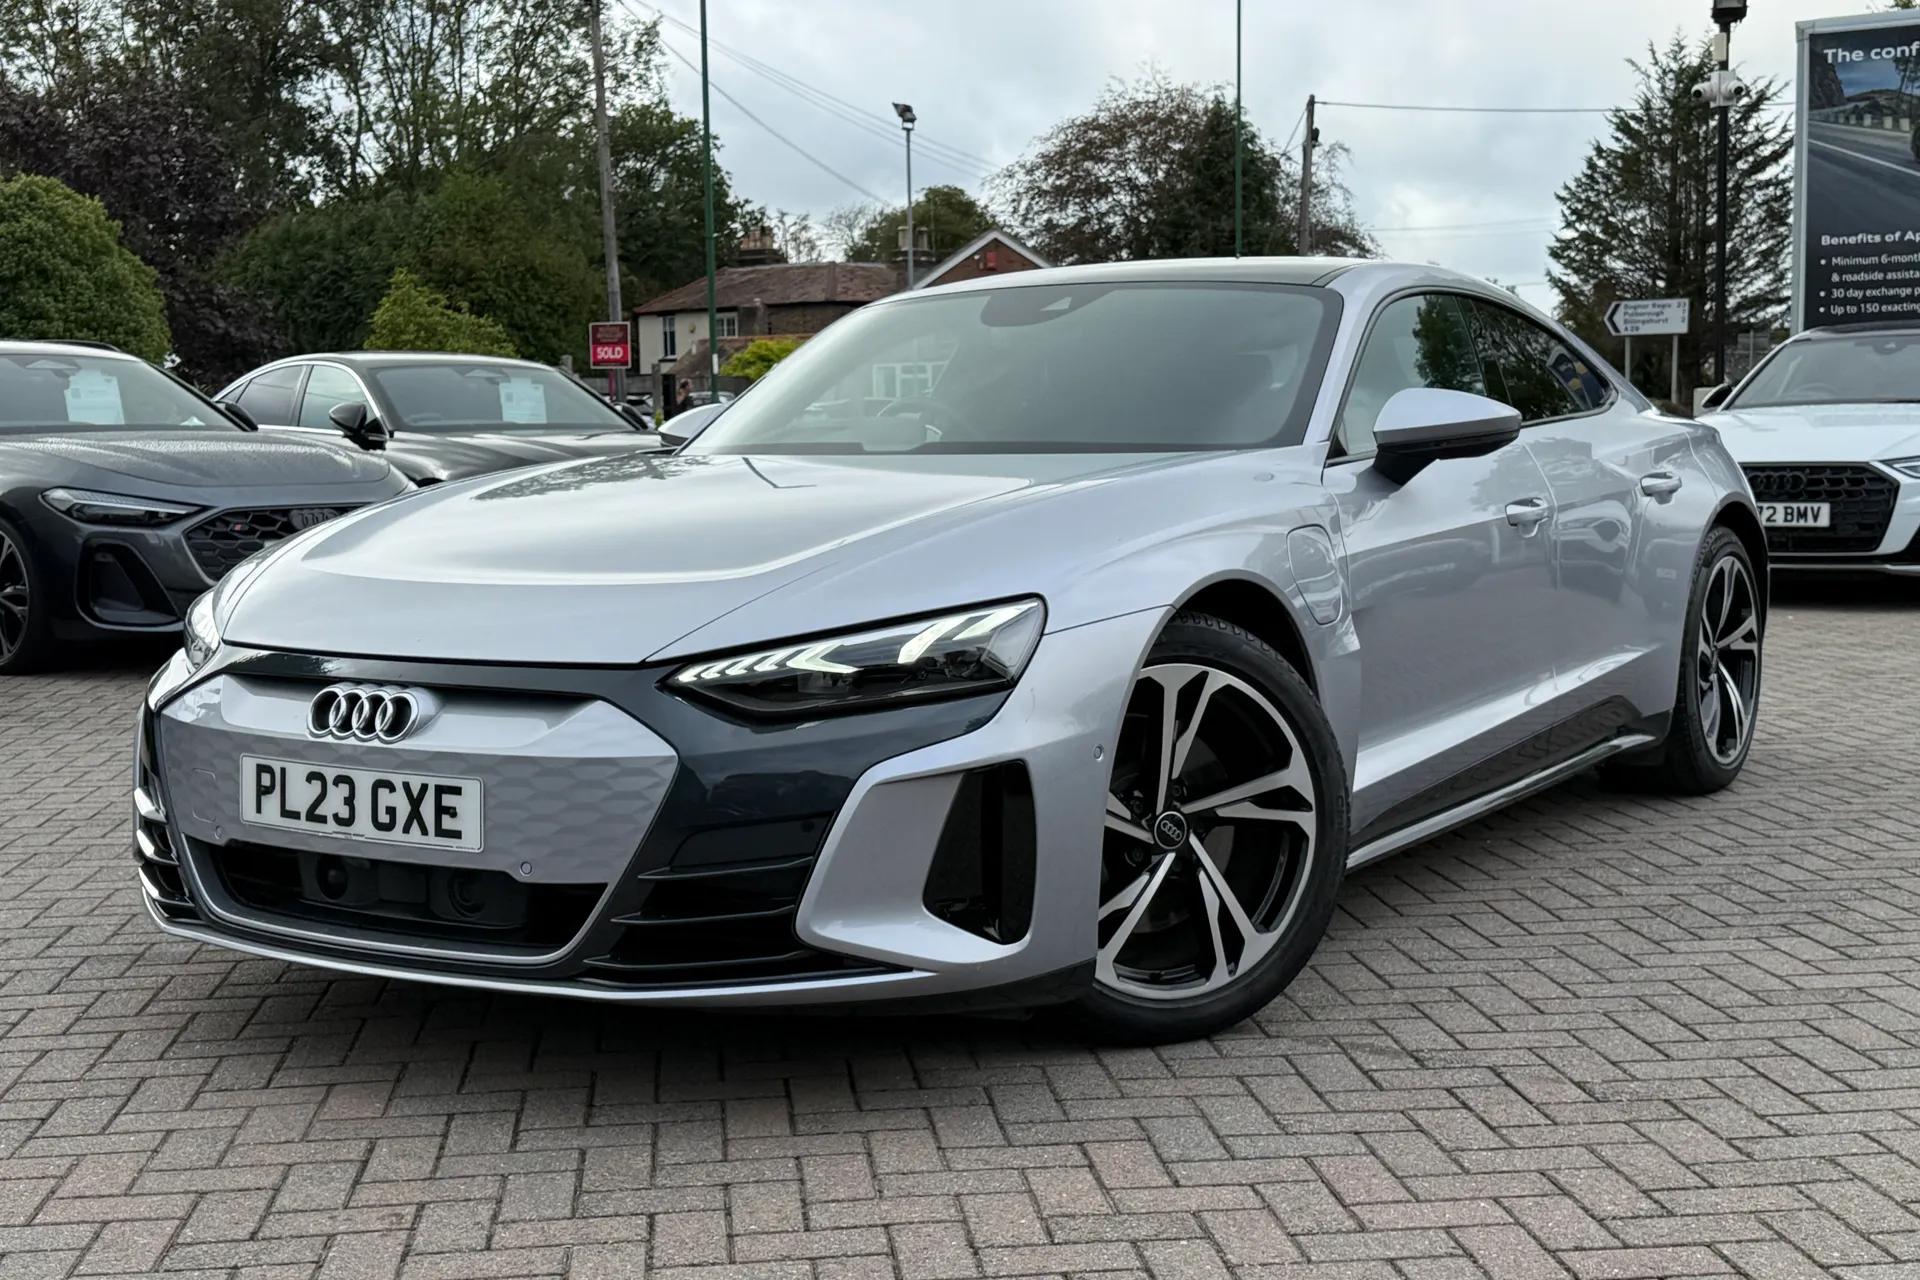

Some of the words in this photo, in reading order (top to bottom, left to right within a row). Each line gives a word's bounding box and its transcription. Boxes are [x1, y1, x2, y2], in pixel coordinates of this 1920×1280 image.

[1823, 48, 1864, 64] The
[1870, 41, 1920, 60] conf
[1821, 232, 1881, 246] Benefits
[1884, 231, 1901, 242] of
[1831, 255, 1879, 266] Minimum
[1831, 272, 1840, 282] &
[1842, 270, 1884, 282] roadside
[1886, 269, 1920, 280] assista
[1831, 288, 1844, 298] 30
[1846, 288, 1864, 299] day
[1865, 286, 1912, 298] exchange
[1830, 304, 1844, 316] Up
[1846, 305, 1858, 314] to
[1860, 302, 1880, 314] 150
[597, 347, 623, 359] SOLD
[1783, 506, 1821, 523] BMV
[255, 763, 356, 828] PL23
[370, 778, 463, 840] GXE
